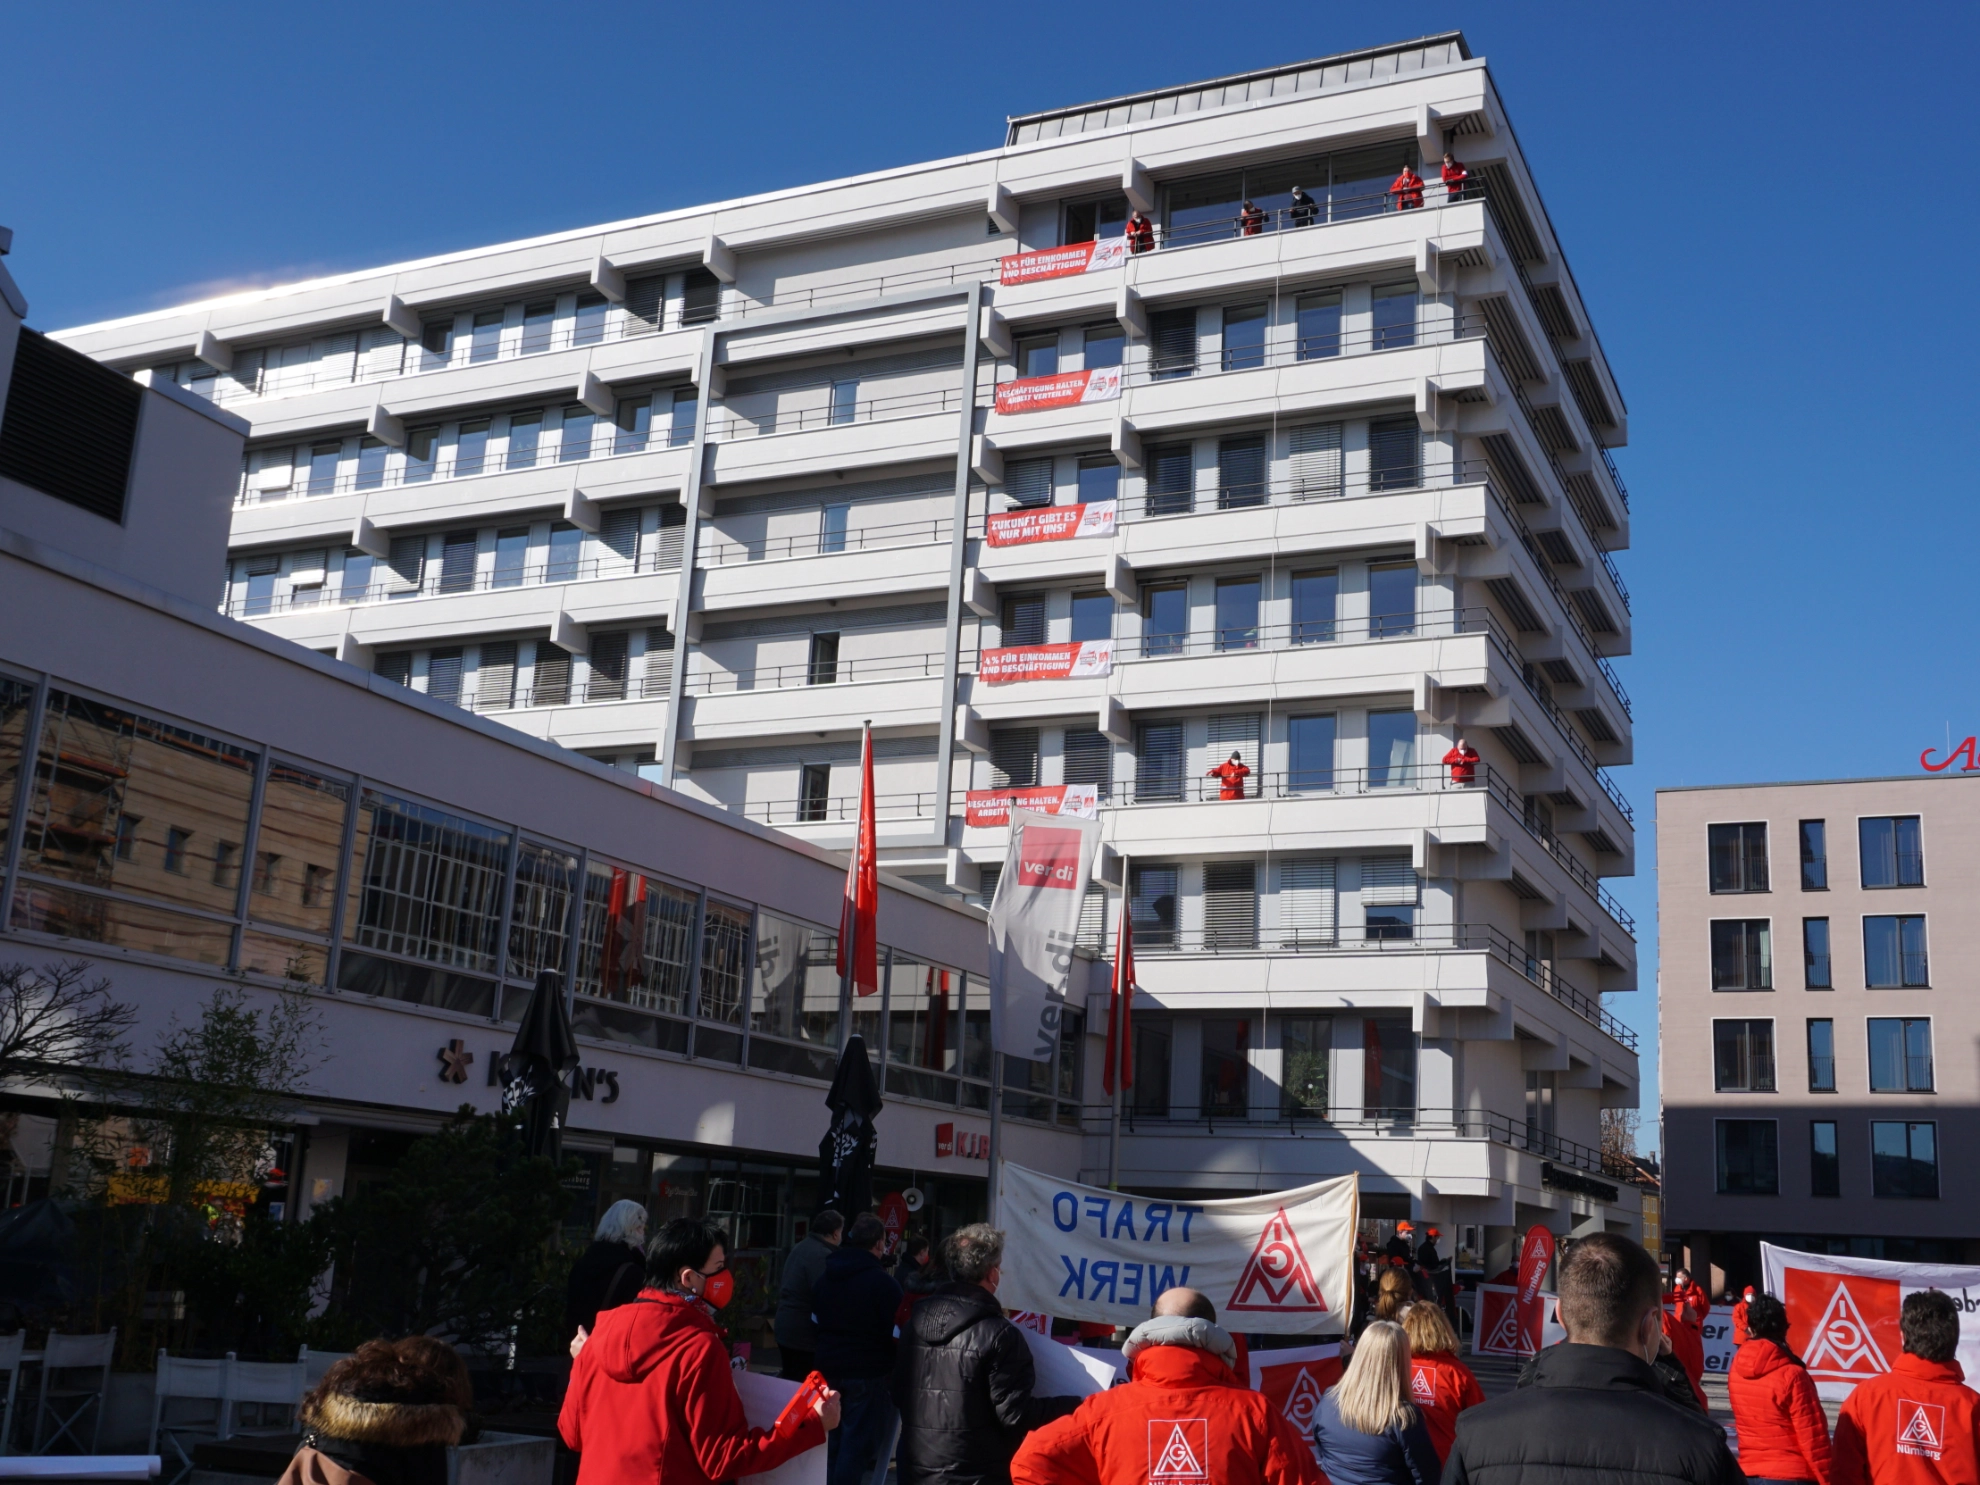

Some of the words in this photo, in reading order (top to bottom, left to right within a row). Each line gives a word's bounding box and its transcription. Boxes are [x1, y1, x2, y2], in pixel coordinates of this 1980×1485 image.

[1011, 260, 1019, 268] %
[1020, 256, 1036, 268] FÜR
[1038, 249, 1087, 266] EINKOMMEN
[1003, 268, 1020, 279] UND
[1021, 258, 1087, 277] BESCHÄFTIGUNG
[1056, 378, 1085, 390] HALTEN.
[1007, 394, 1033, 405] ARBEIT
[1033, 388, 1074, 401] VERTEILEN.
[991, 515, 1037, 531] ZUKUNFT
[1038, 512, 1063, 525] GIBT
[1064, 511, 1077, 522] ES
[998, 528, 1020, 540] NUR
[1021, 525, 1042, 538] MIT
[1042, 523, 1067, 535] UNS!
[991, 655, 1000, 665] %
[1001, 651, 1018, 664] FÜR
[1019, 651, 1071, 662] EINKOMMEN
[982, 665, 1000, 675] UND
[1001, 660, 1071, 674] BESCHÄFTIGUNG
[1920, 736, 1980, 772] A
[1029, 796, 1060, 806] HALTEN.
[977, 807, 1006, 817] ARBEIT
[1024, 860, 1074, 882] ver.di
[1522, 1259, 1547, 1305] Nürnberg
[1896, 1443, 1943, 1461] Nürnberg
